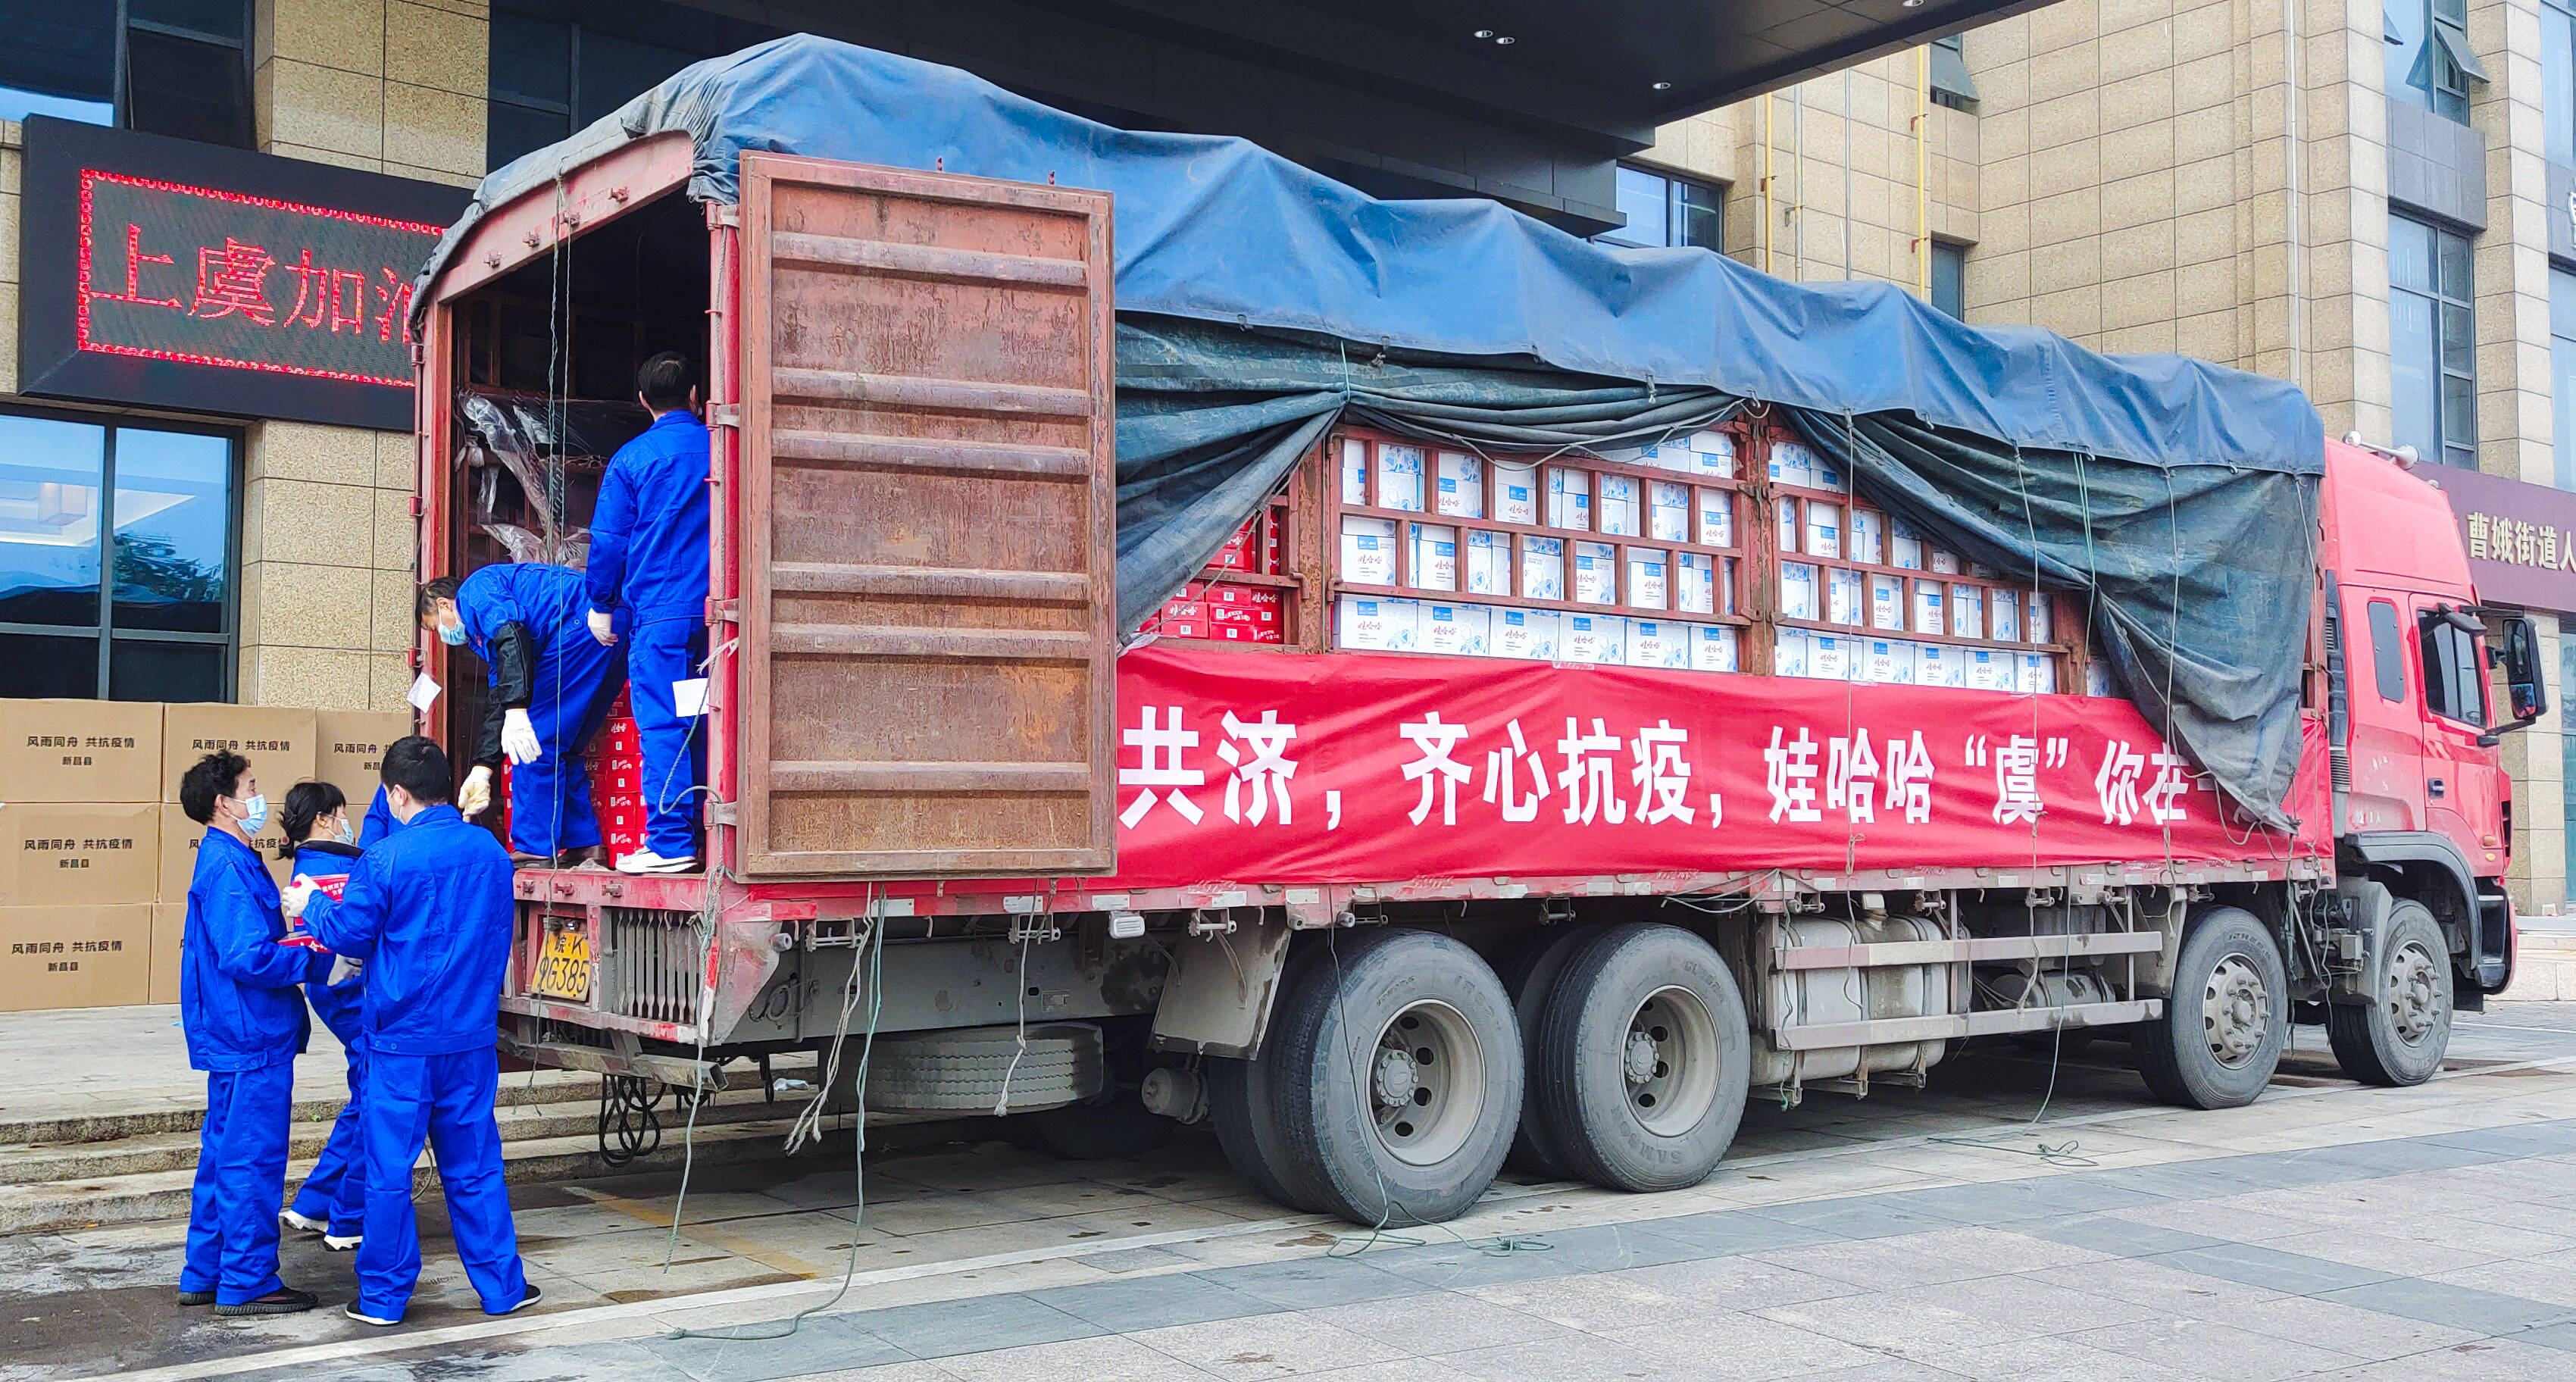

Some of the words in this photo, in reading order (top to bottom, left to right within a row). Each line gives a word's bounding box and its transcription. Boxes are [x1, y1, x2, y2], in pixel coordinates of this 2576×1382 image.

[2466, 511, 2576, 574] 曹娥街道人
[27, 736, 79, 748] 风雨同舟
[85, 737, 135, 749] 共抗疫情
[192, 739, 239, 751] 风雨同舟
[245, 739, 290, 752] 共抗疫情
[334, 743, 377, 754] 风雨同舟
[23, 839, 76, 851] 风雨同舟
[83, 838, 133, 850] 共抗疫情
[11, 942, 64, 955] 风雨同舟
[72, 940, 123, 953] 共抗疫情
